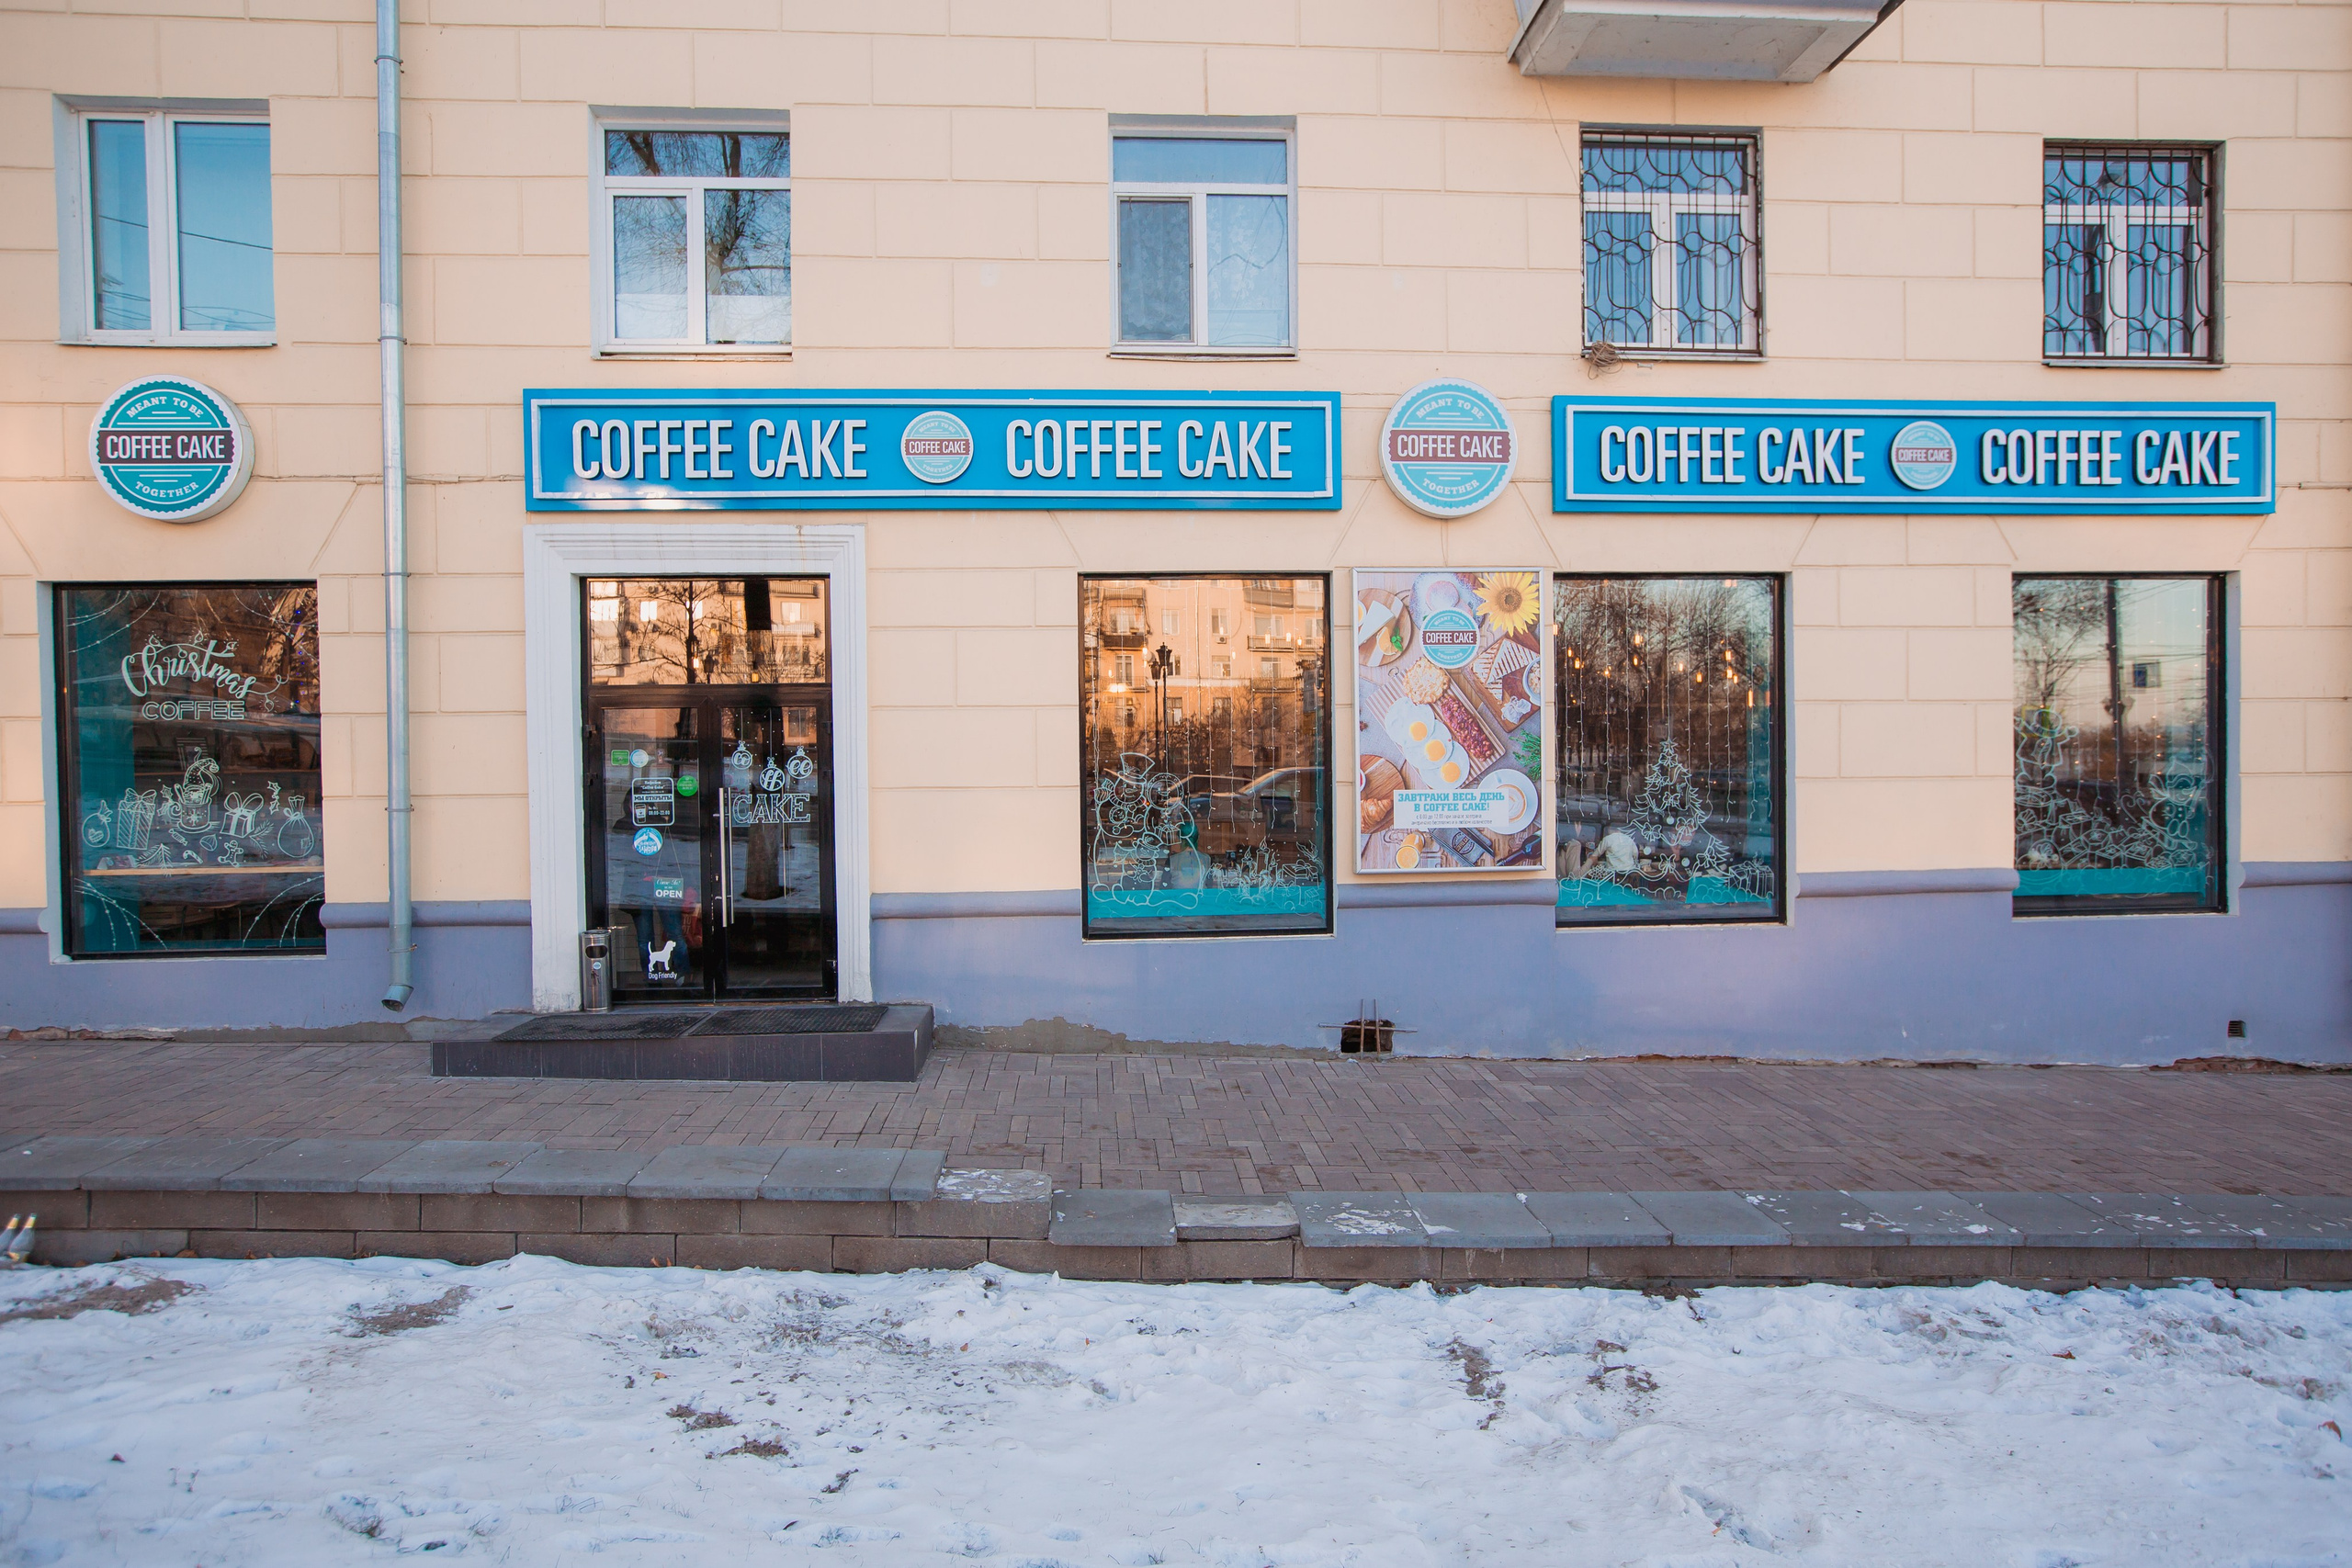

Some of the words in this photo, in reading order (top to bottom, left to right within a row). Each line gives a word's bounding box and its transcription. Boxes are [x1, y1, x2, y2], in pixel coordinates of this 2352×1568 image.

[126, 396, 167, 418] MEANT
[173, 397, 188, 409] TO
[188, 404, 204, 418] BE
[1416, 398, 1453, 418] MEANT
[1457, 399, 1472, 411] TO
[1473, 407, 1485, 420] BE
[106, 435, 173, 459] COFFEE
[176, 435, 225, 459] CAKE
[572, 419, 734, 479] COFFEE
[749, 419, 867, 479] CAKE
[909, 441, 940, 454] COFFEE
[942, 441, 967, 454] CAKE
[1006, 419, 1163, 478] COFFEE
[1178, 420, 1293, 479] CAKE
[1396, 434, 1455, 457] COFFEE
[1460, 435, 1503, 458] CAKE
[1600, 425, 1746, 484] COFFEE
[1758, 427, 1866, 484] CAKE
[1898, 449, 1927, 461] COFFEE
[1928, 449, 1950, 461] CAKE
[1981, 428, 2122, 485] COFFEE
[2135, 429, 2241, 485] CAKE
[135, 481, 199, 498] TOGETHER
[1422, 479, 1480, 495] TOGETHER
[1426, 632, 1452, 643] COFFEE
[1453, 632, 1474, 643] CAKE
[121, 640, 257, 699] Christmas
[141, 700, 245, 721] COFFEE
[1397, 792, 1450, 802] ЗАВТРАКИ
[1453, 792, 1476, 801] ВЕСЬ
[1479, 792, 1505, 802] ДЕНЬ
[1414, 803, 1420, 812] В
[1423, 803, 1459, 812] COFFEE
[1462, 802, 1489, 811] CAKE!
[733, 793, 810, 823] CAKE
[655, 889, 683, 898] OPEN
[649, 972, 658, 980] Dog
[659, 971, 677, 980] Friendly
